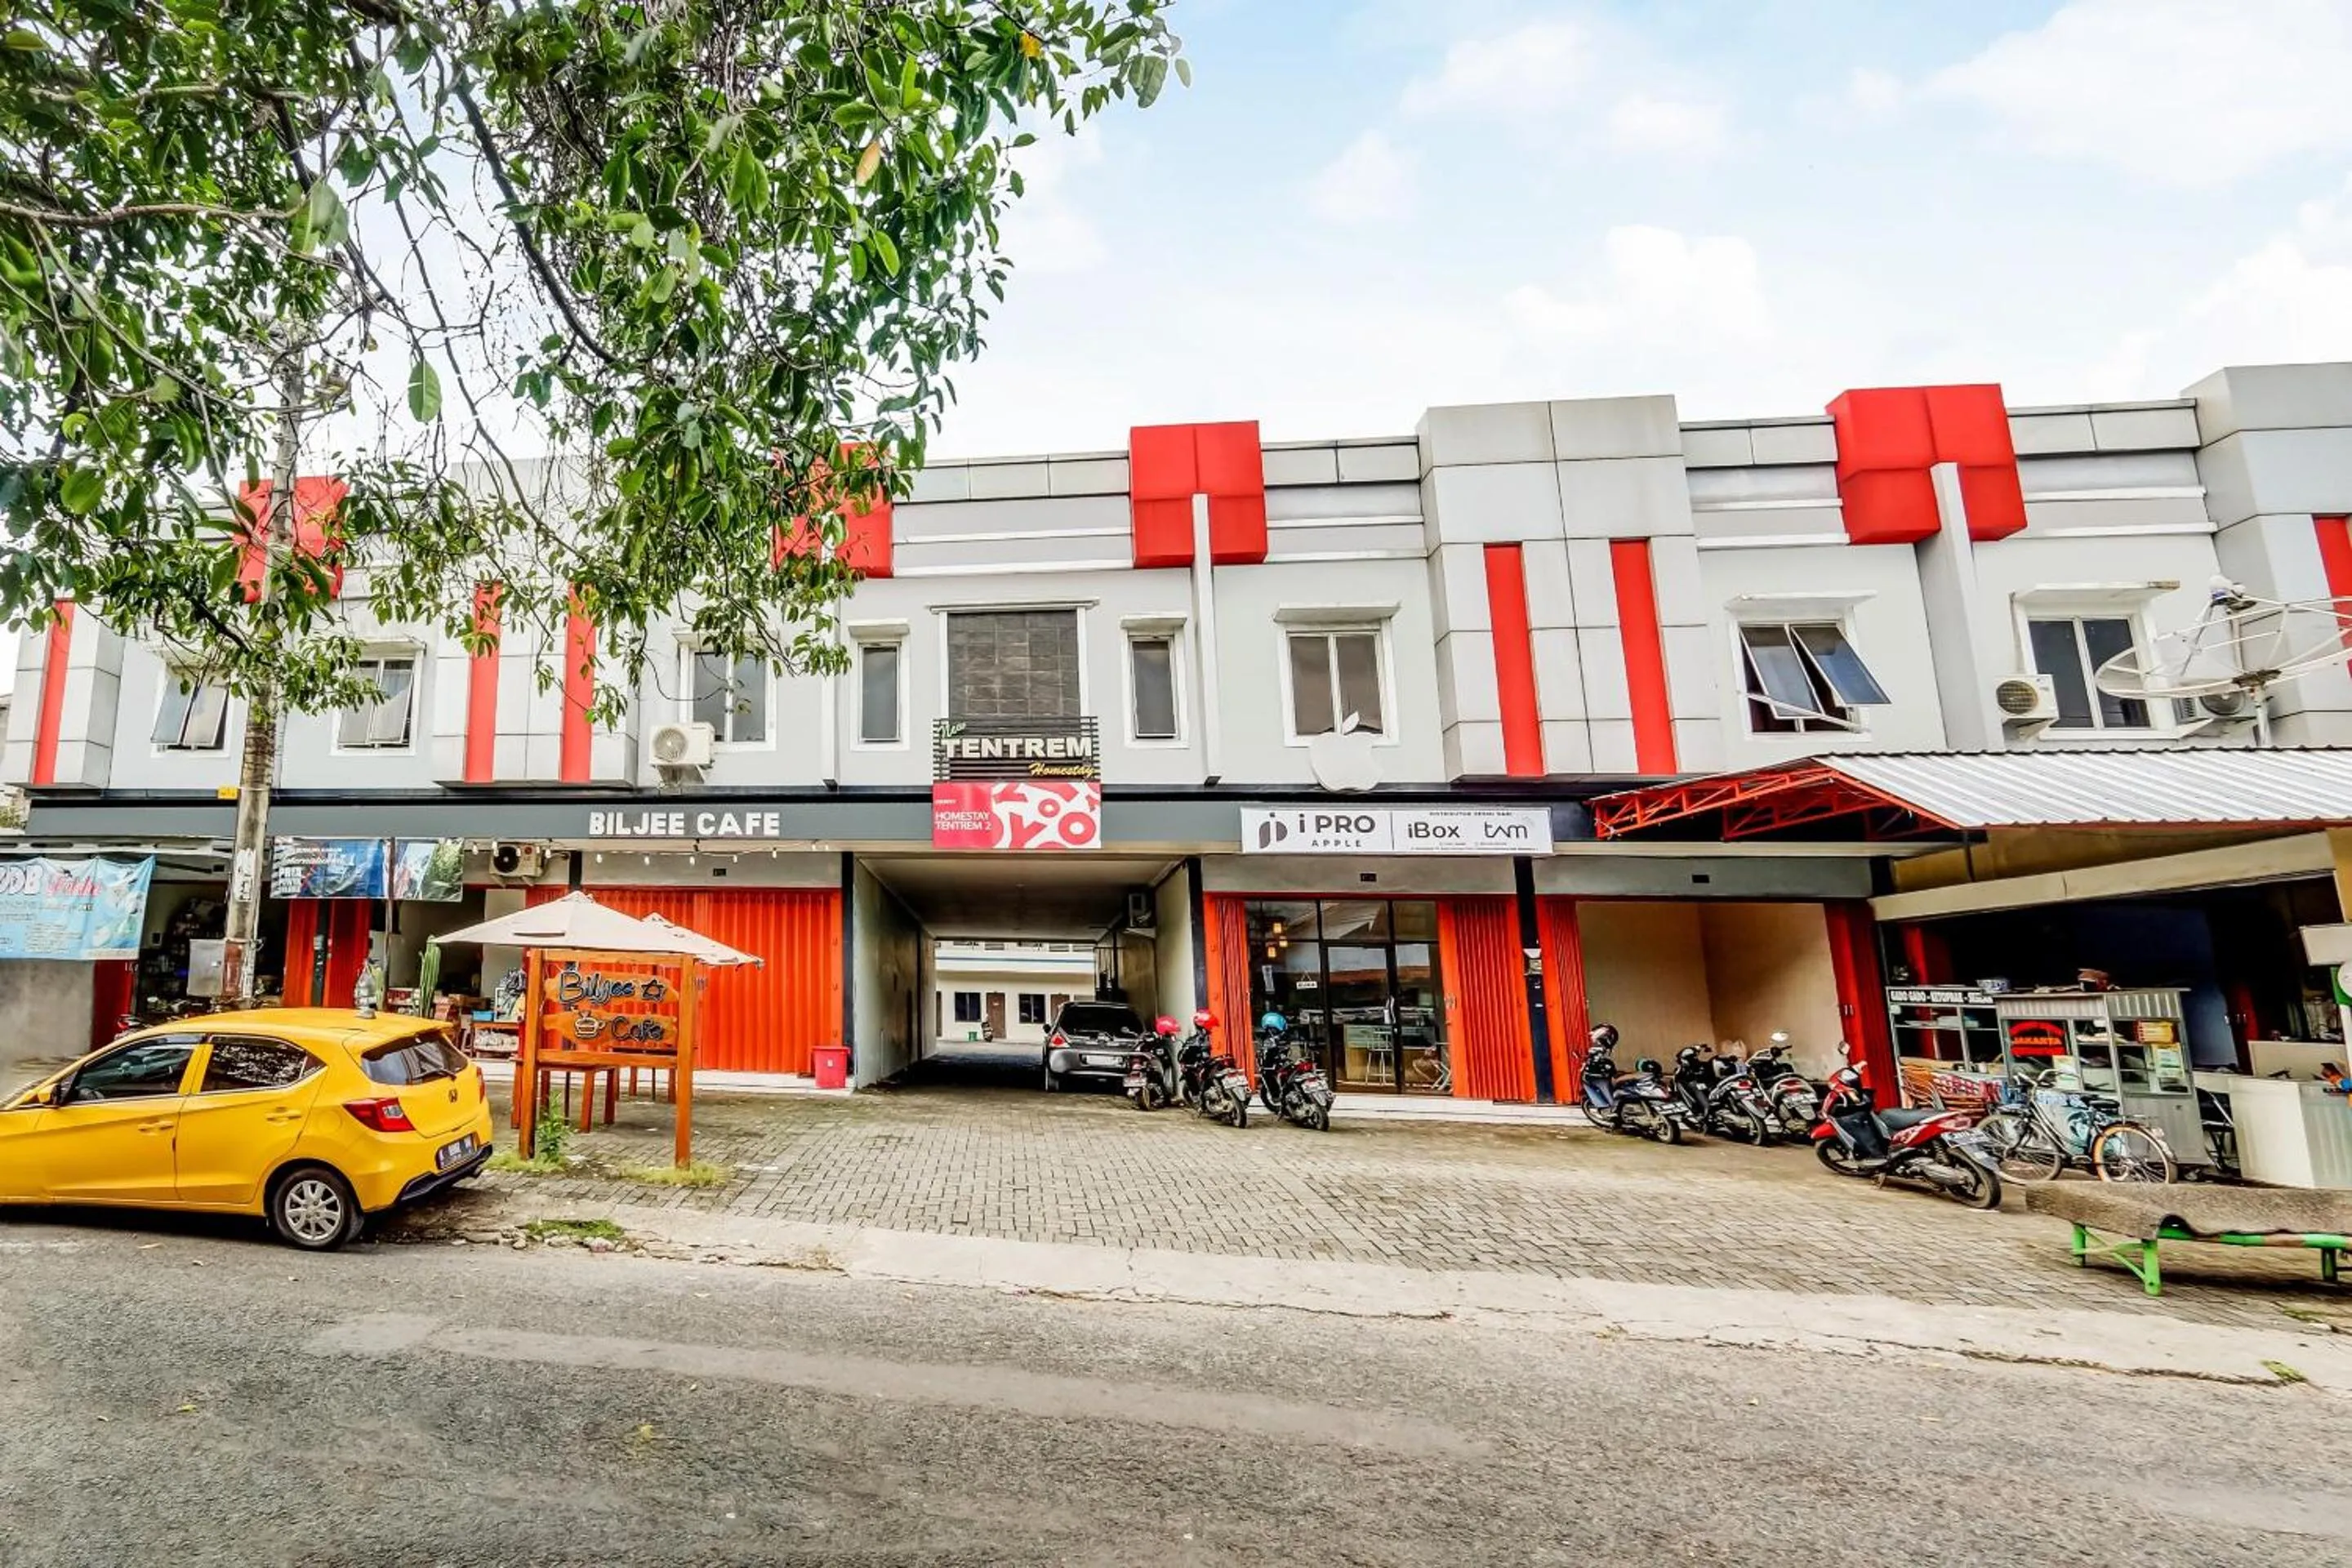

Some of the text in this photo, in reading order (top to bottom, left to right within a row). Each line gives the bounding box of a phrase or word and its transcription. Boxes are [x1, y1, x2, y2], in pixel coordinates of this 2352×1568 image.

[941, 737, 1093, 759] TENTREM
[1028, 762, 1095, 777] Homestay
[589, 812, 780, 835] BILJEE CAFE
[935, 811, 990, 821] HOMESTAY
[1315, 815, 1375, 833] PRO
[934, 821, 992, 831] TENTREM 2
[1408, 822, 1460, 839] iBox
[1311, 840, 1361, 848] APPLE
